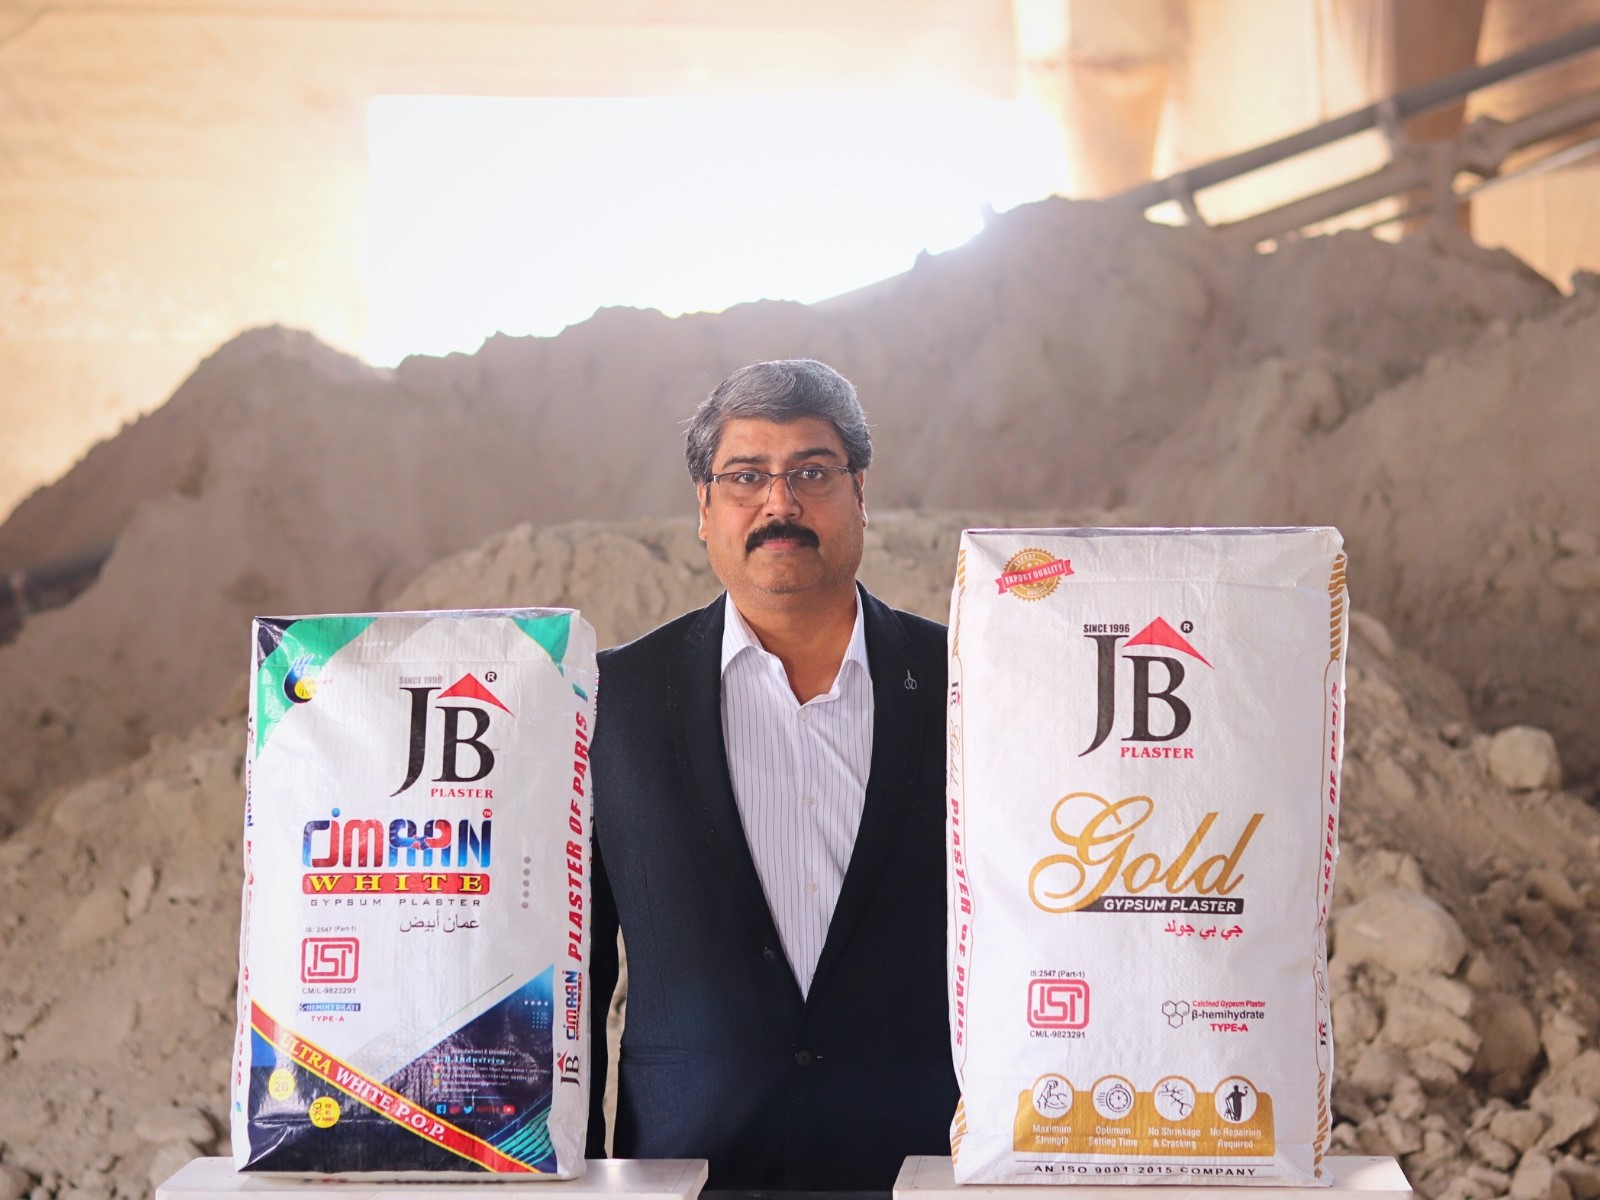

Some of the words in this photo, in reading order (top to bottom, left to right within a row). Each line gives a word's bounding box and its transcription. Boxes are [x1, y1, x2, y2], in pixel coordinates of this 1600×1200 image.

[1004, 572, 1032, 584] EXPORT
[1032, 563, 1063, 578] QUALITY
[1083, 624, 1107, 633] SINCE
[1109, 624, 1130, 633] 1996
[399, 676, 421, 684] SINCE
[1078, 635, 1192, 758] JB
[389, 687, 495, 797] JB
[572, 711, 588, 797] PARIS
[1120, 747, 1194, 759] PLASTER
[430, 788, 494, 799] PLASTER
[569, 798, 583, 836] OF
[1028, 792, 1264, 914] Gold
[308, 874, 482, 892] WHITE
[566, 840, 583, 962] PLASTER
[1104, 899, 1166, 911] GYPSUM
[1170, 900, 1236, 912] PLASTER
[400, 910, 440, 933] أبيض
[443, 914, 480, 932] عمان
[1164, 920, 1195, 937] جولد
[1199, 924, 1217, 940] بي
[1220, 924, 1243, 940] جي
[1058, 970, 1085, 978] (Part-1)
[1210, 1023, 1248, 1032] TYPE-A
[1029, 1030, 1086, 1039] CM/L-9823291
[560, 1055, 580, 1086] JB
[280, 1032, 332, 1074] ULTRA
[336, 1066, 394, 1110] WHITE
[394, 1105, 445, 1140] P.O.P.
[1032, 1124, 1072, 1134] Maximum
[1096, 1126, 1131, 1136] Optimum
[1148, 1127, 1159, 1136] No
[1161, 1126, 1201, 1137] Shrinkage
[1210, 1128, 1220, 1136] No
[1223, 1128, 1261, 1137] Repairing
[1036, 1136, 1069, 1146] Strength
[1088, 1136, 1116, 1148] Setting
[1119, 1137, 1138, 1147] Time
[1161, 1139, 1196, 1149] Cracking
[1217, 1139, 1253, 1149] Required
[1062, 1166, 1087, 1174] ISO
[1180, 1167, 1256, 1176] COMPANY
